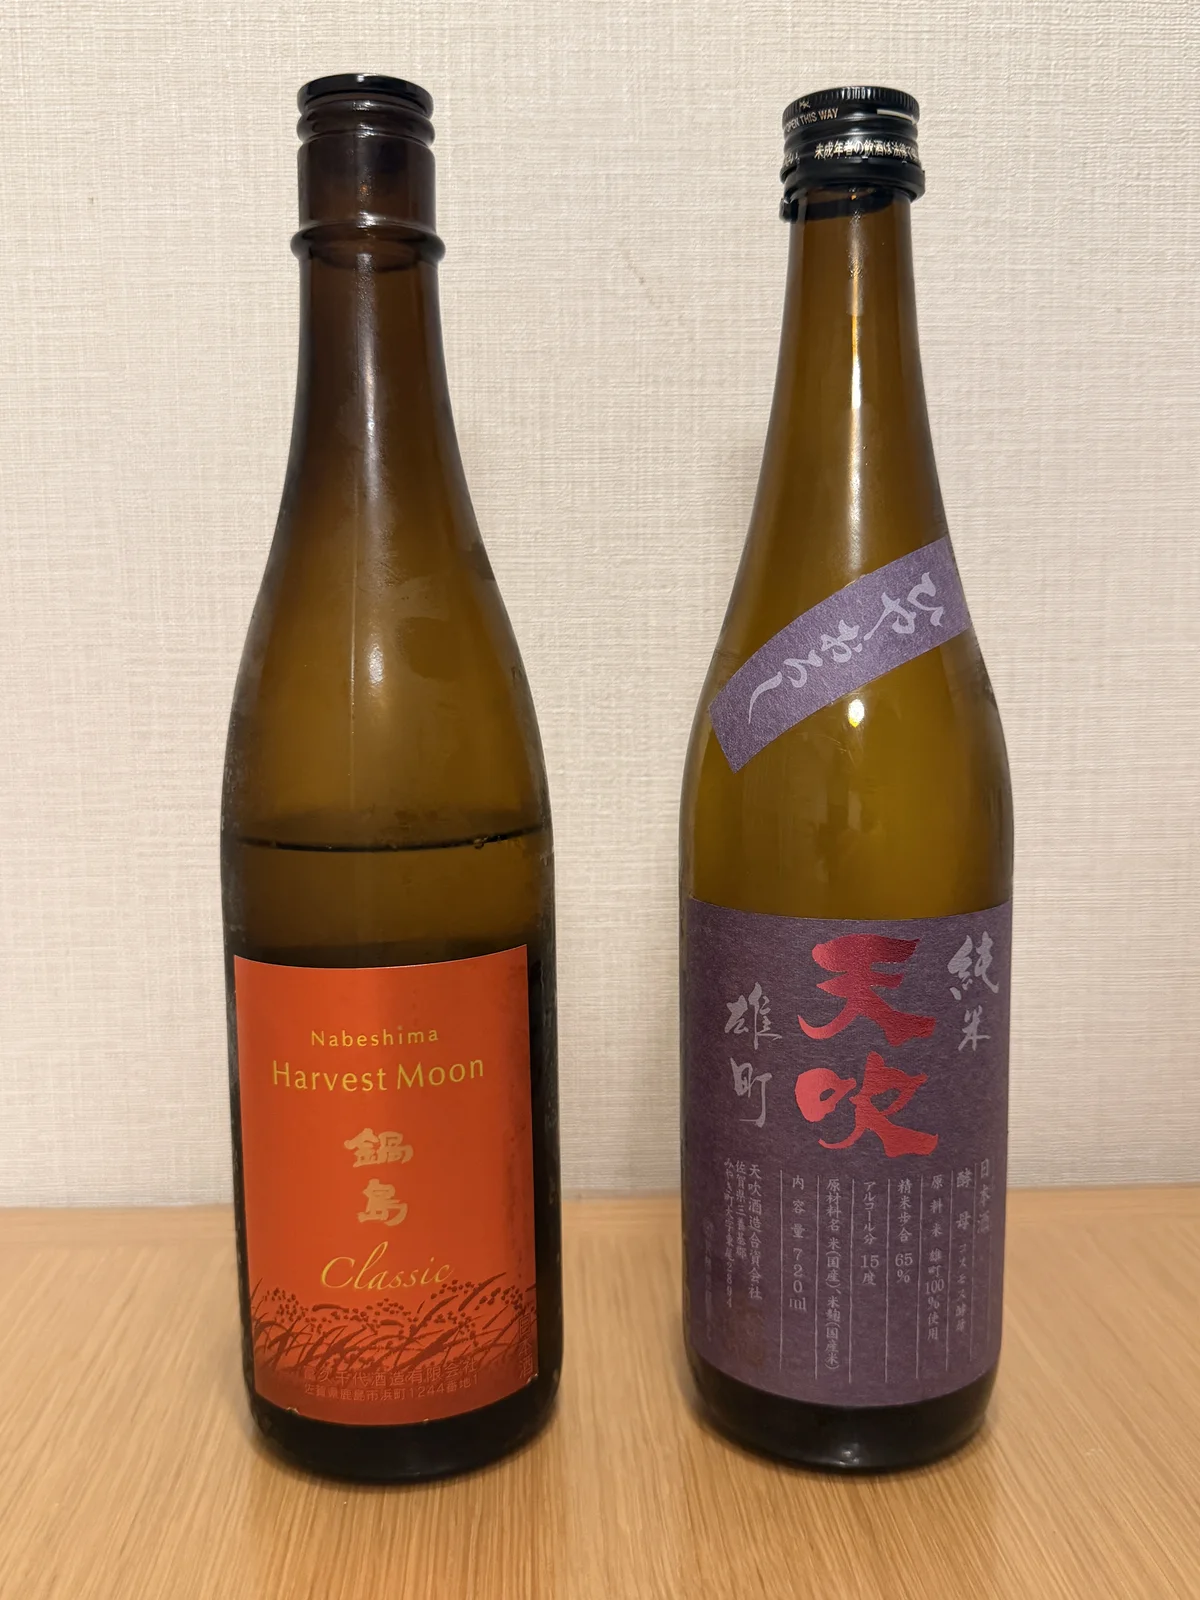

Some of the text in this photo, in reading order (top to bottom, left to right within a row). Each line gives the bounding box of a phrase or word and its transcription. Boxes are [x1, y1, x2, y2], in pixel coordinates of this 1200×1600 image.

[784, 108, 839, 133] OPEN THIS WAY
[748, 571, 944, 725] ひやおろし
[311, 1026, 439, 1047] Nabeshima
[947, 931, 999, 1051] 純米
[272, 1059, 484, 1092] Harvest Moon
[724, 982, 783, 1128] 雄町
[794, 933, 939, 1158] 天吹
[343, 1128, 414, 1226] 鍋島
[320, 1241, 454, 1291] Classic
[748, 1164, 763, 1301] 天吹酒造合資会社
[519, 1313, 534, 1379] 日本酒
